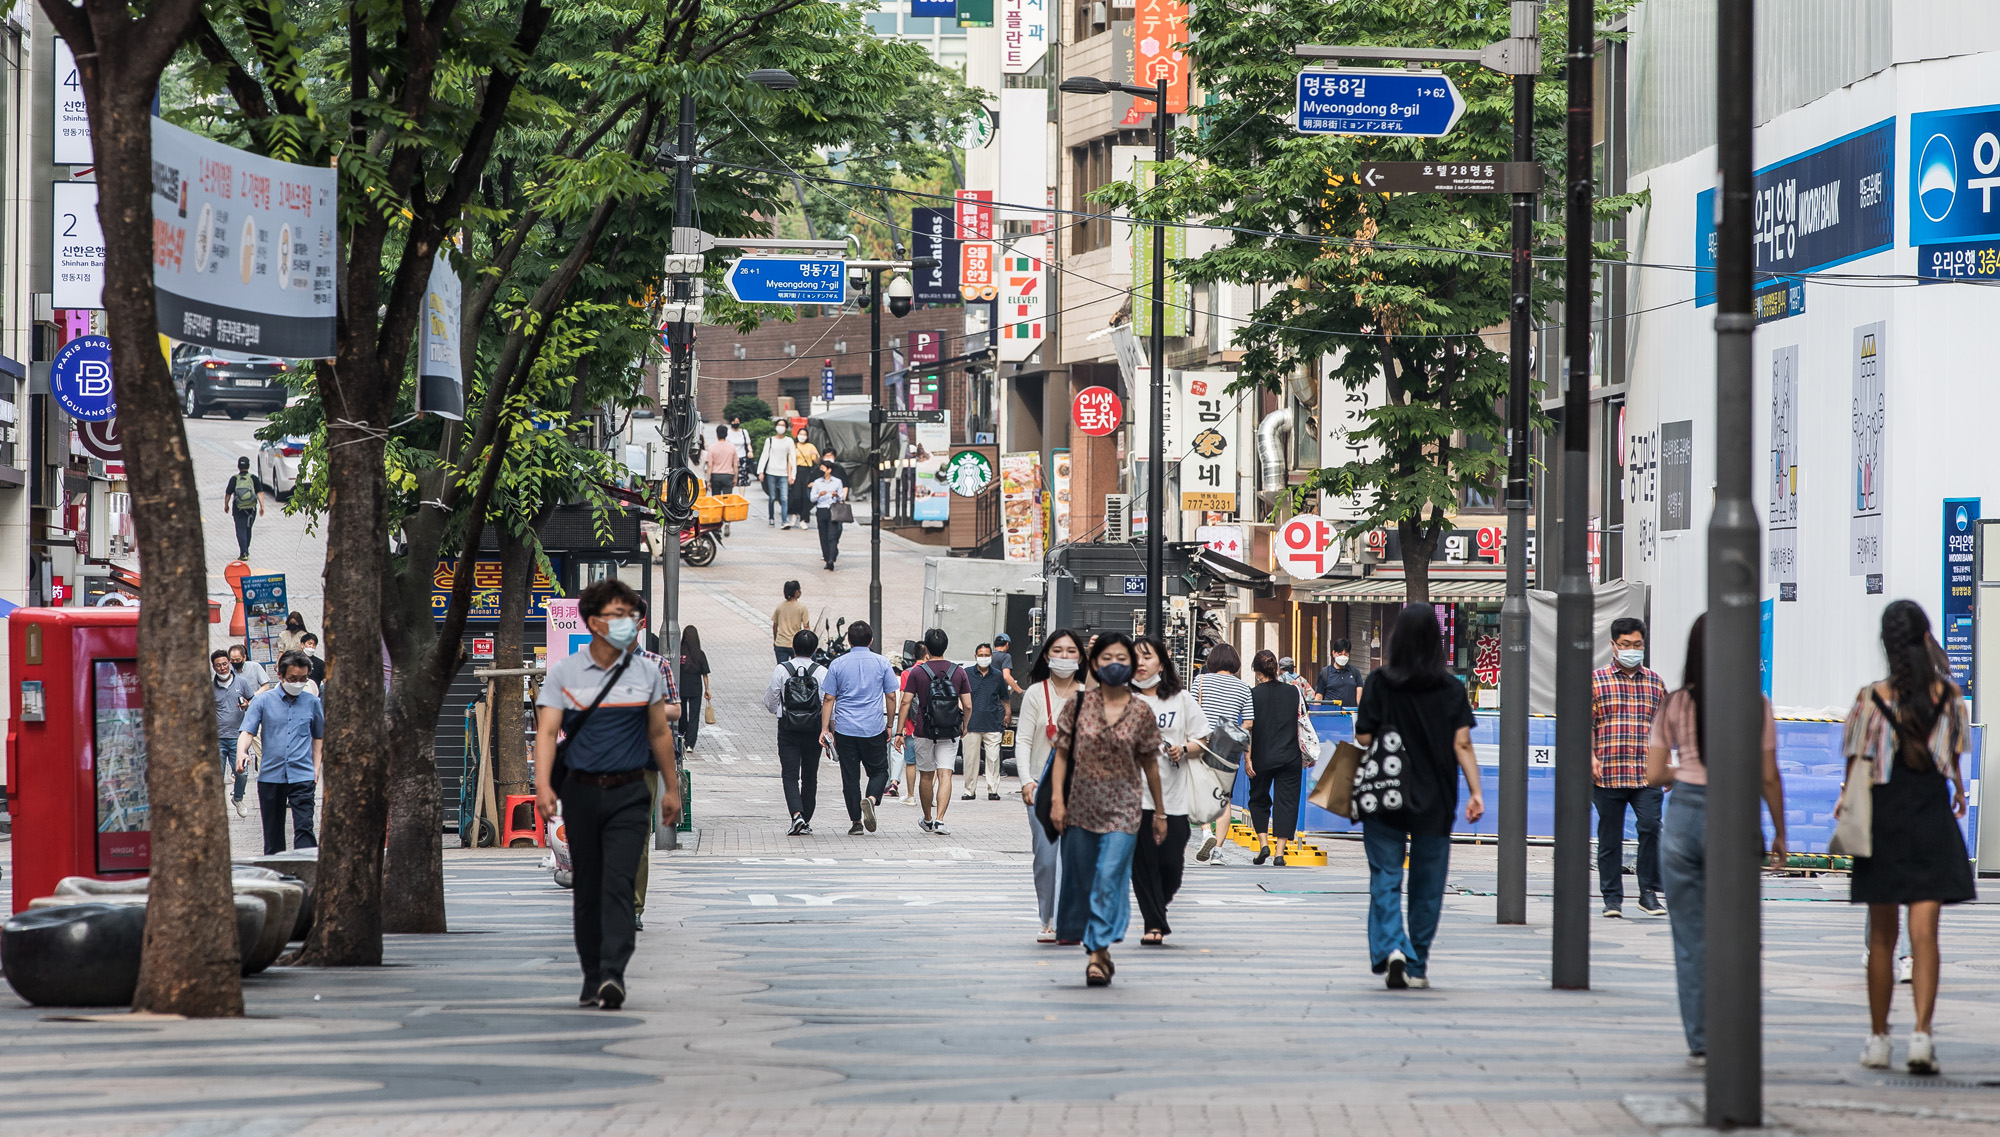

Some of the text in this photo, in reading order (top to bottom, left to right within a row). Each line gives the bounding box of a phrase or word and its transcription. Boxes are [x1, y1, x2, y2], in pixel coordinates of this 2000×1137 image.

[63, 69, 80, 92] 4
[1303, 77, 1366, 98] 명동8길
[1417, 88, 1446, 98] 1 62
[1303, 100, 1420, 118] Myeongdong 8-gil
[1303, 119, 1403, 131] 明洞8街 ミョンドン8ギル
[1798, 179, 1841, 238] WOORI BANK
[62, 213, 78, 237] 2
[1753, 178, 1797, 268] 우리은행
[62, 246, 106, 258] 신한은행
[740, 267, 749, 275] 26
[799, 263, 840, 278] 명동7길
[969, 260, 985, 270] 50
[1931, 249, 1976, 278] 우리은행
[61, 273, 91, 282] 명동지점
[966, 271, 988, 282] 안경
[766, 279, 839, 291] Myeongdong 7-gil
[918, 333, 931, 352] P
[57, 343, 81, 370] PARIS
[1079, 392, 1113, 413] 인생
[1079, 411, 1117, 430] 포차
[1187, 500, 1231, 510] 777-3231
[1203, 540, 1238, 551] 珍香
[1284, 520, 1330, 574] 약
[1444, 535, 1468, 565] 원
[1476, 526, 1502, 564] 약
[1948, 534, 1974, 552] 우리은행
[1126, 581, 1145, 591] 50-1
[551, 606, 578, 619] 明洞
[552, 618, 578, 630] Foot
[1534, 749, 1549, 764] 전
